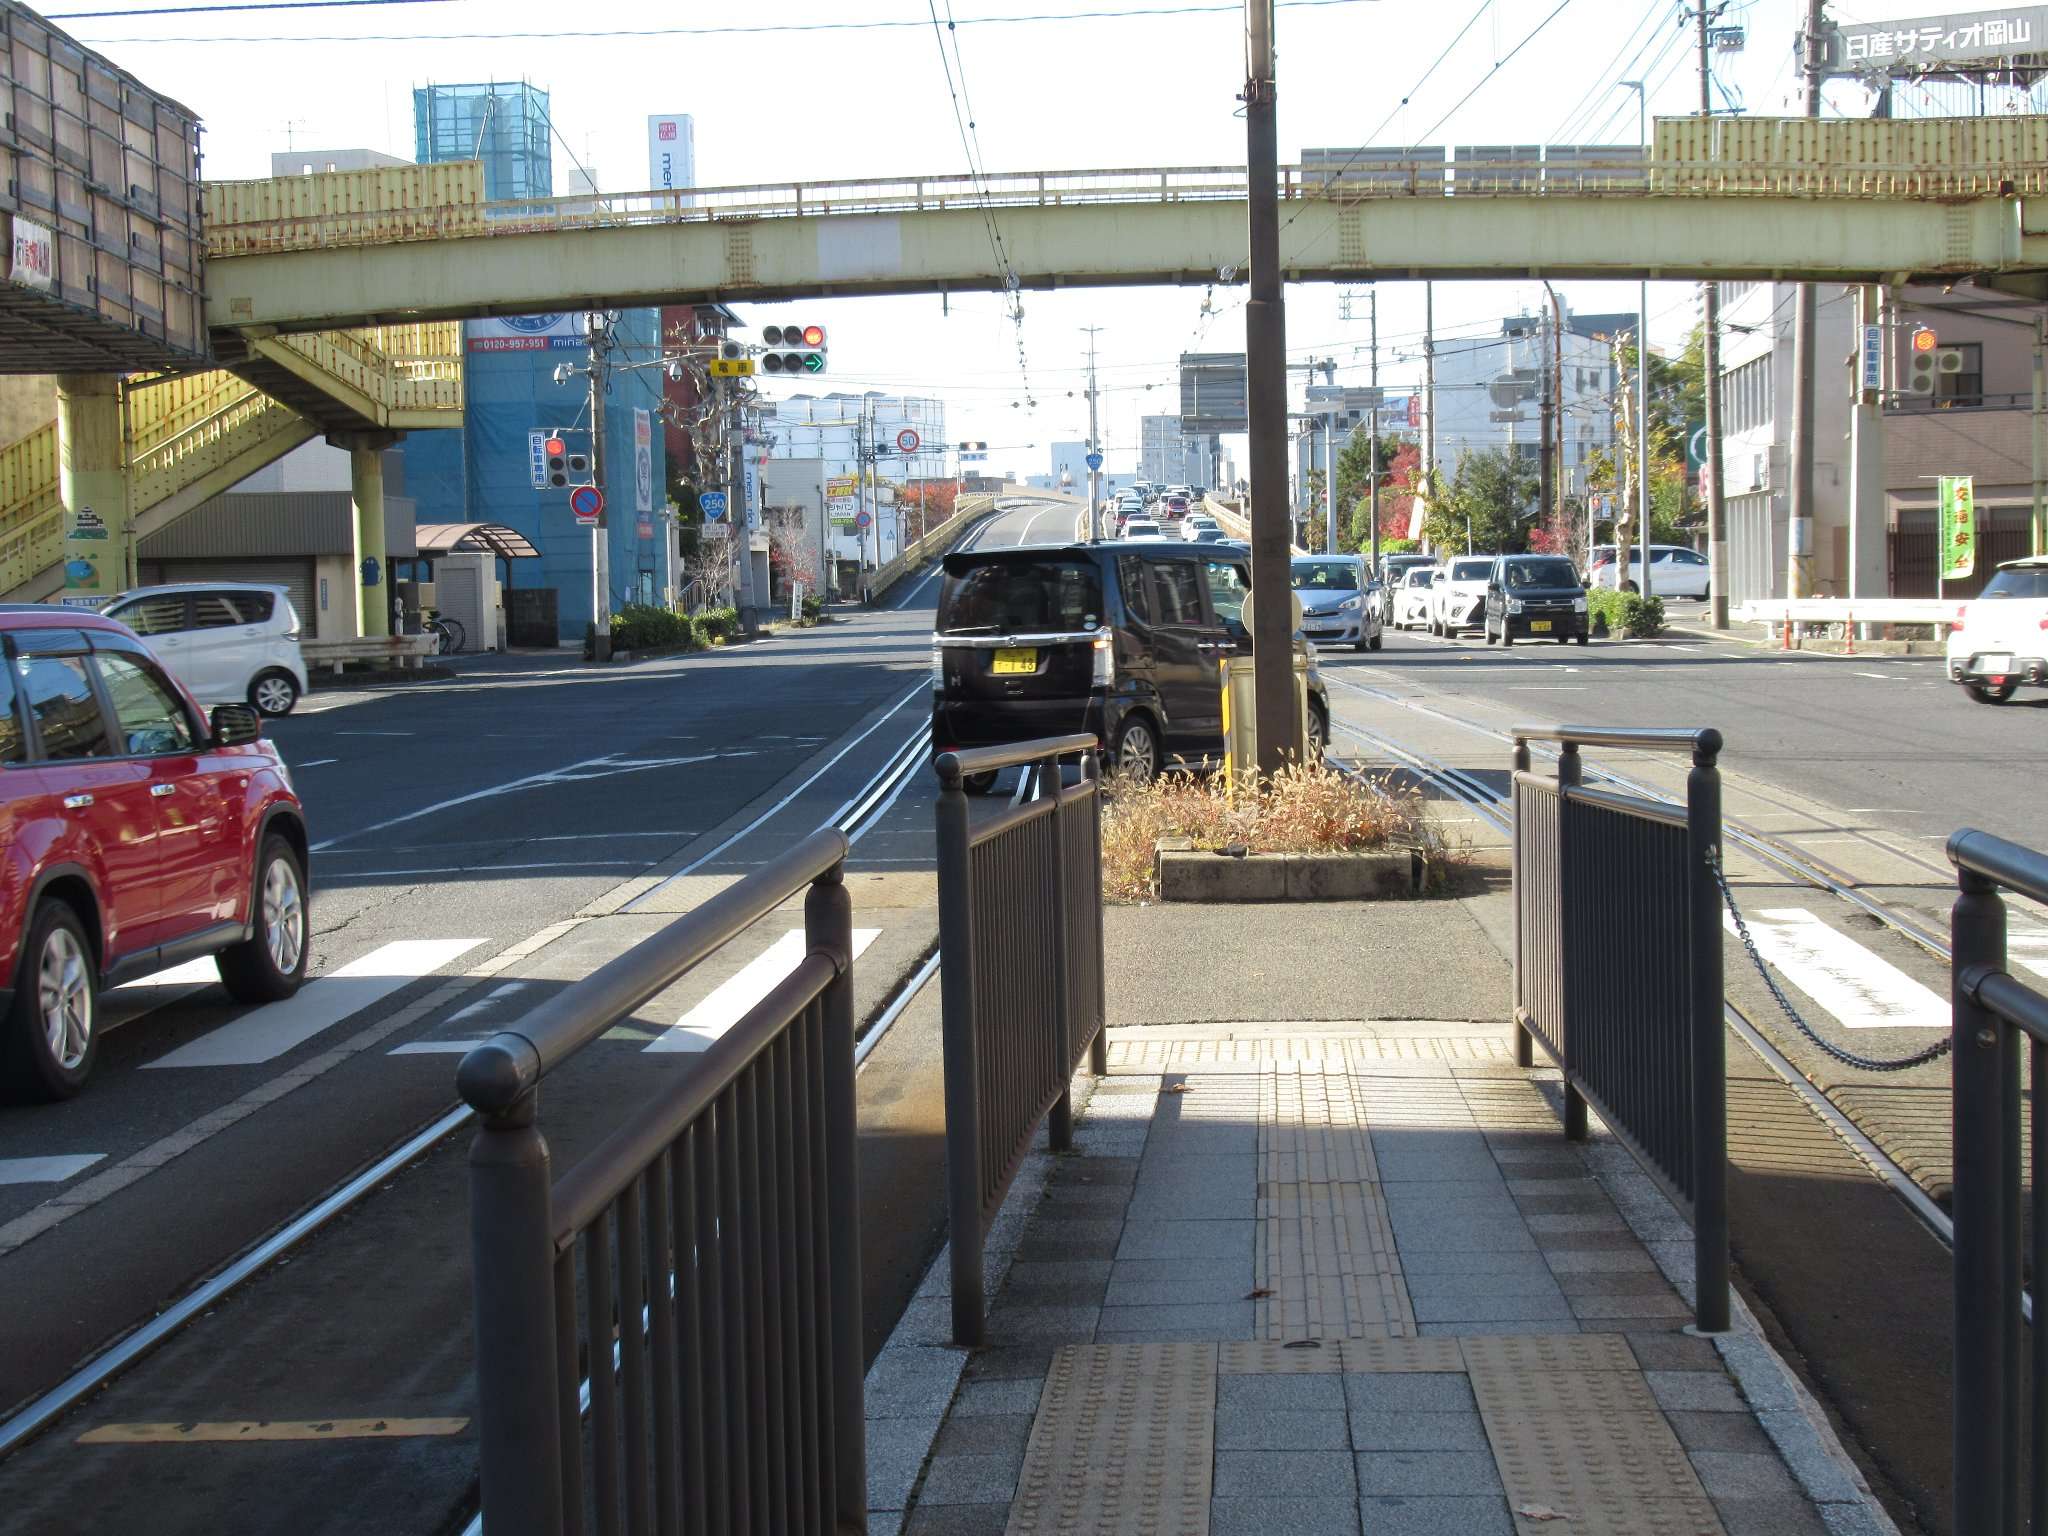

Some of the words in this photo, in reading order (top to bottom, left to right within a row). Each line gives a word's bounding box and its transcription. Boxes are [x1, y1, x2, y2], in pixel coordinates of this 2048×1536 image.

[1846, 18, 2031, 60] 日産サティオ岡山
[483, 338, 544, 349] 0120-957-951
[1866, 328, 1879, 385] 自転車専用
[718, 360, 748, 374] 電車
[902, 435, 915, 446] 50
[532, 435, 545, 482] 自転車専用
[704, 498, 725, 510] 250
[1954, 486, 1969, 569] 交通安全
